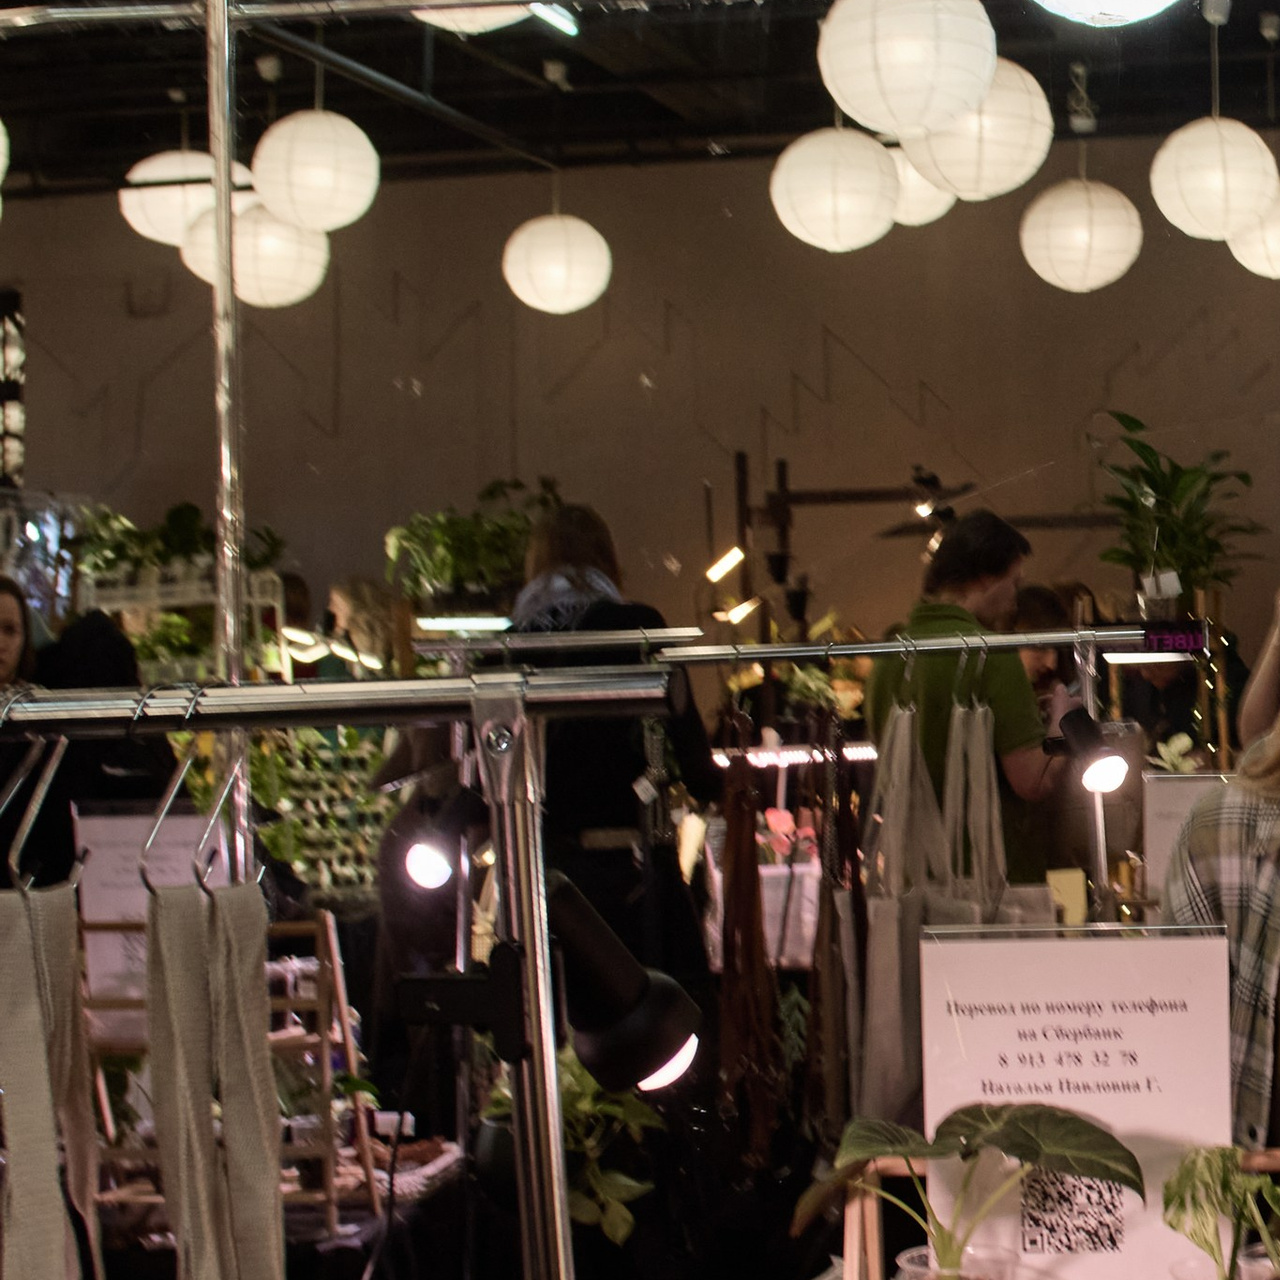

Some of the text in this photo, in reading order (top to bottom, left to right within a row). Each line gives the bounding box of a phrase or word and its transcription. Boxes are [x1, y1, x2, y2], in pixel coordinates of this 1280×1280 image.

[946, 996, 1188, 1020] Перевод по номеру телефона
[1017, 1023, 1124, 1044] на Сбербанк
[998, 1049, 1139, 1069] 8 913 478 32 78
[981, 1078, 1053, 1096] Наталья
[1057, 1077, 1142, 1095] Павловна
